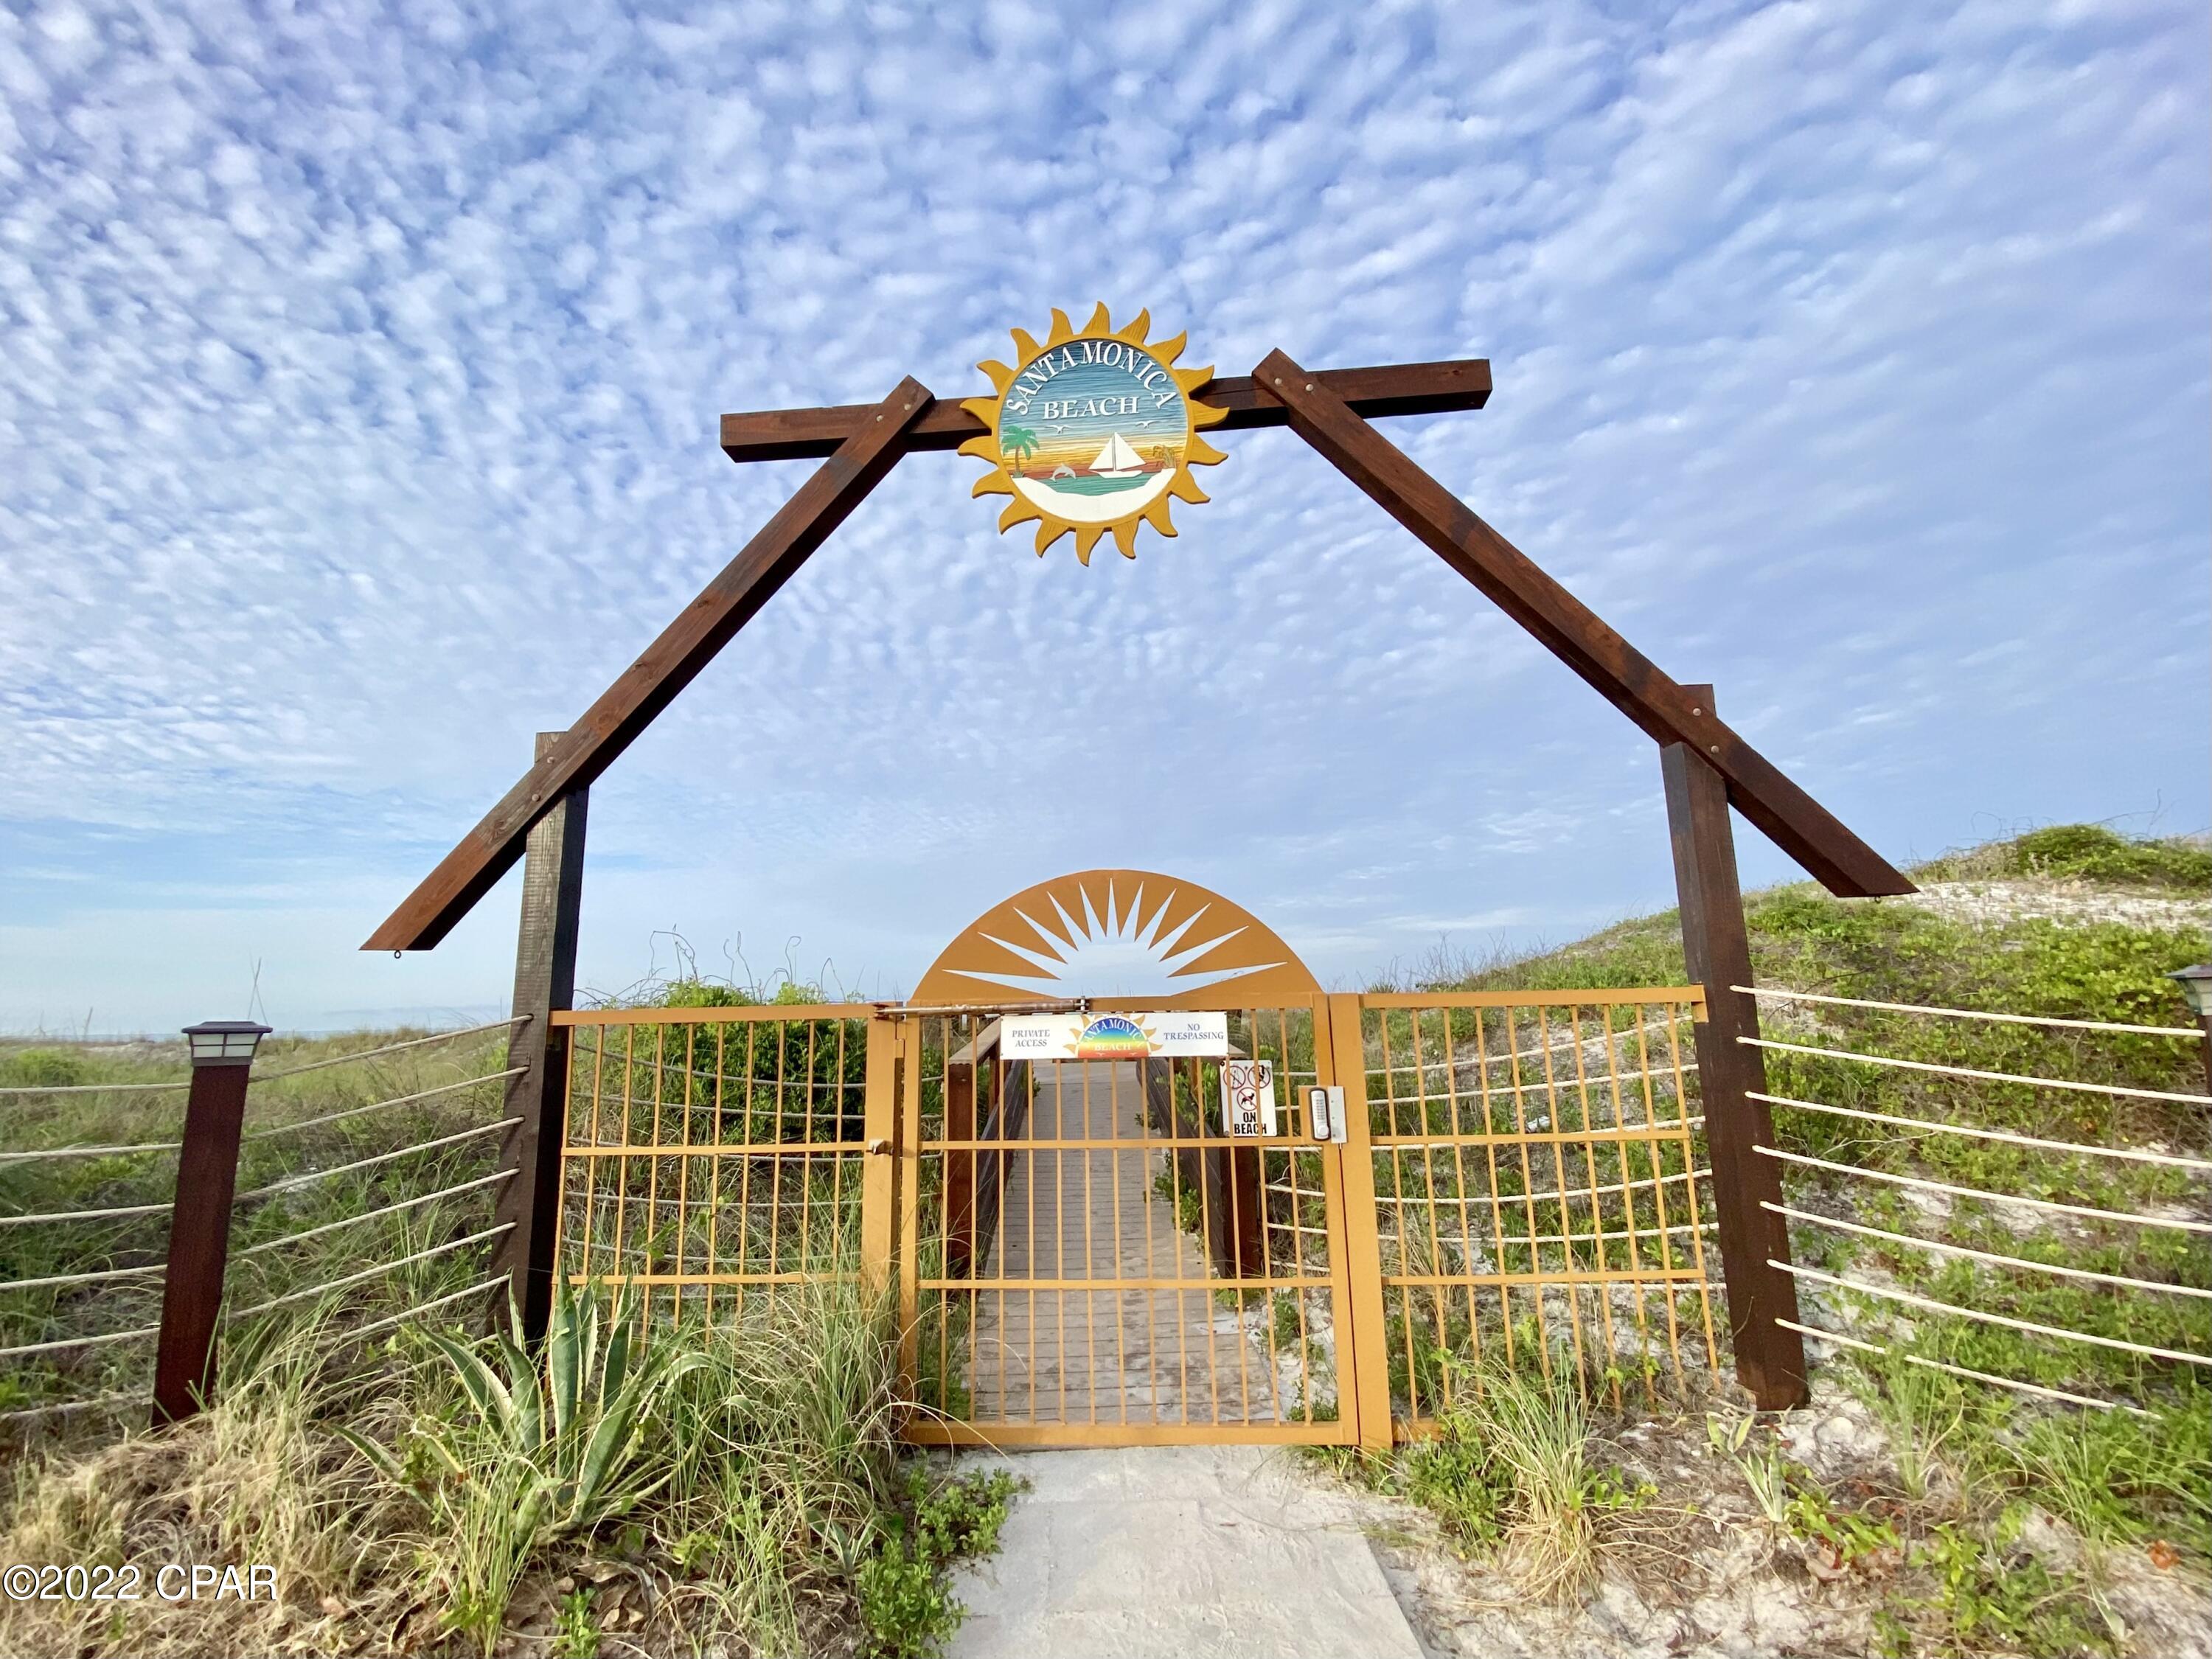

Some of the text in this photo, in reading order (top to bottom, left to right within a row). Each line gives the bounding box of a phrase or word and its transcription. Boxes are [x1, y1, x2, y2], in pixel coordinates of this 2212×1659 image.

[1006, 341, 1178, 416] SANTA MONICA
[1042, 396, 1140, 420] BEACH
[1187, 1023, 1200, 1032] NO
[1012, 1029, 1051, 1038] PRIVATE
[1164, 1032, 1224, 1040] TRESPASSING
[1015, 1039, 1048, 1047] ACCESS
[1094, 1043, 1131, 1051] BEACH
[1242, 1112, 1256, 1123] ON
[1234, 1123, 1267, 1135] BEACH
